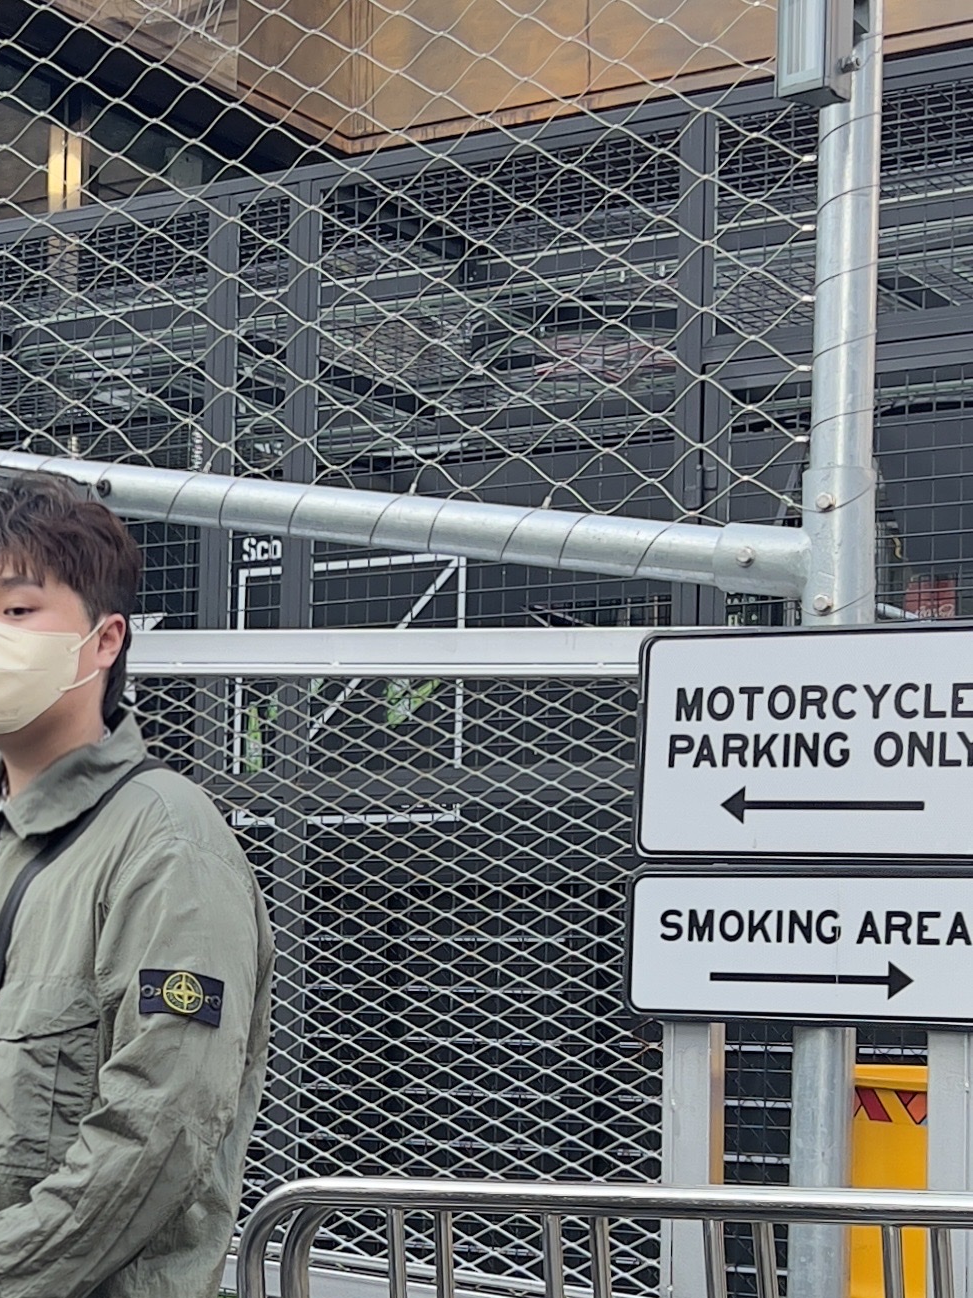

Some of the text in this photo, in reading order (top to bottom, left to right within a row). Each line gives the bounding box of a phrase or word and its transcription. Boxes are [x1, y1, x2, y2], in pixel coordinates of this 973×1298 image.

[675, 682, 973, 722] MOTORCYCLE
[668, 732, 850, 769] PARKING
[659, 908, 972, 946] SMOKING AREA
